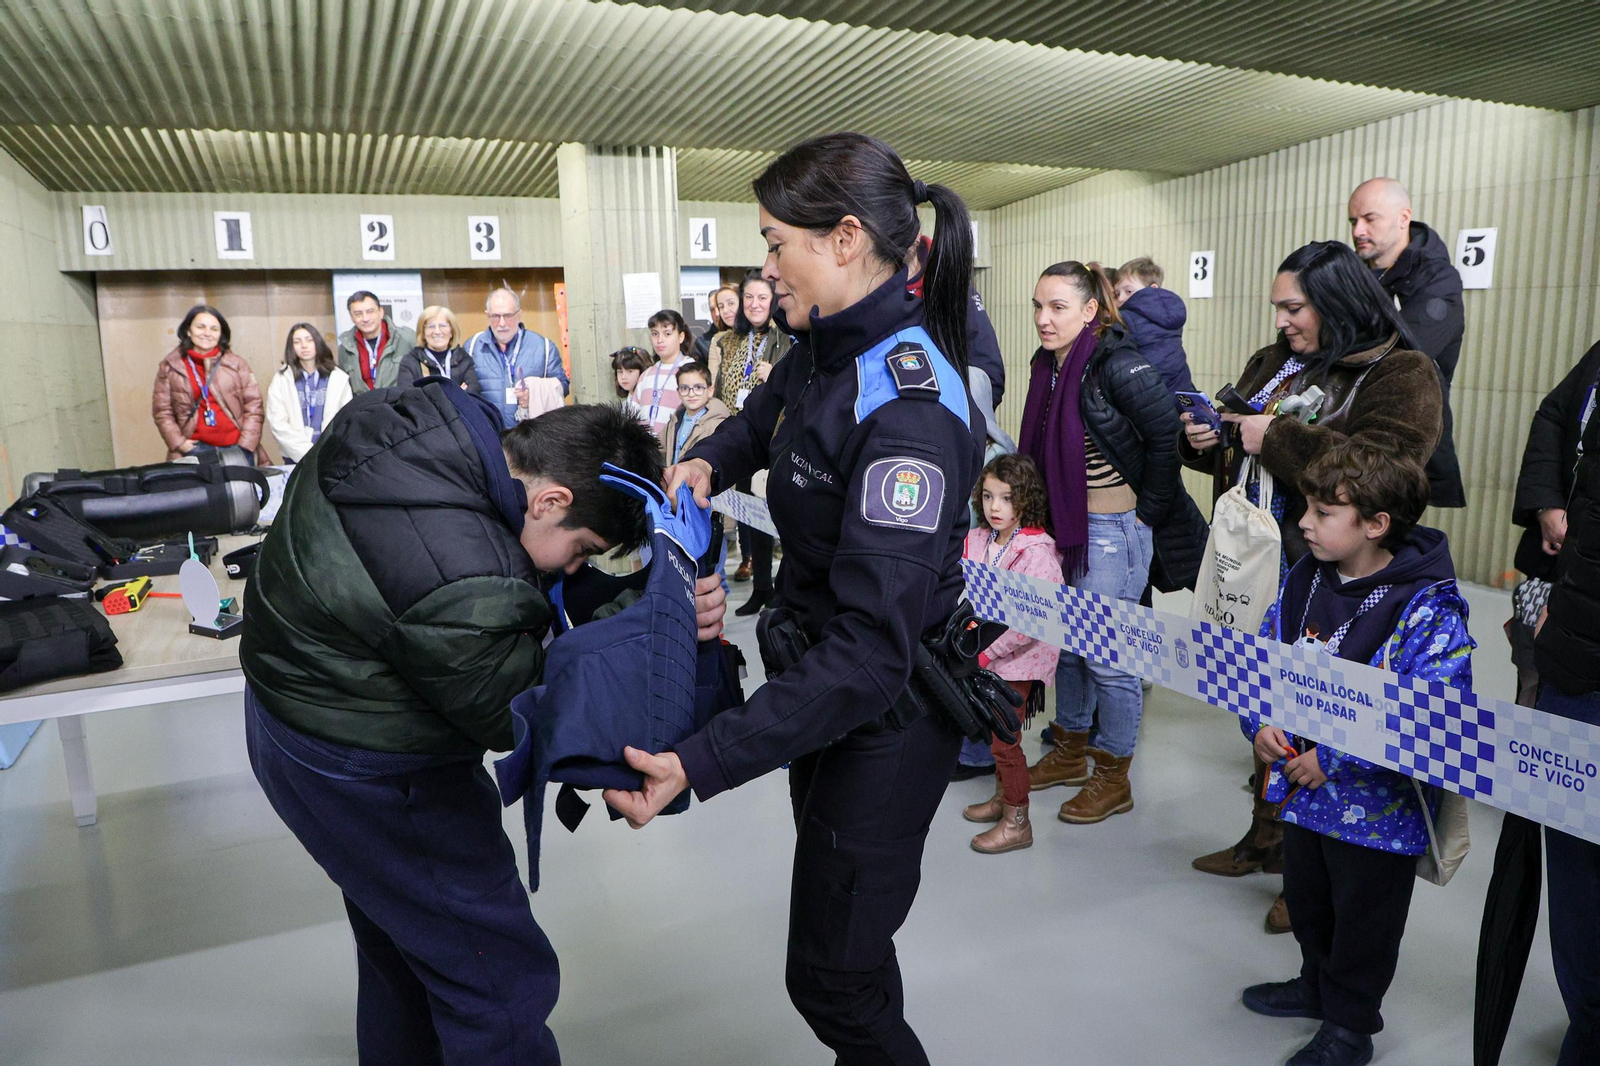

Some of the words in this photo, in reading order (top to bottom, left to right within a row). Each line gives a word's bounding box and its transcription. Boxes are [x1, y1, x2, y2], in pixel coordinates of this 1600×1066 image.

[220, 218, 247, 251] 1
[367, 221, 389, 252] 2
[475, 222, 495, 252] 3
[694, 223, 711, 251] 4
[1462, 235, 1486, 267] 5
[1194, 256, 1208, 280] 3
[792, 471, 808, 488] VIGO
[895, 516, 909, 524] Vigo
[684, 585, 696, 609] VIG
[1003, 585, 1030, 602] POLICIA
[1030, 594, 1054, 609] LOCAL
[1014, 601, 1025, 612] NO
[1026, 605, 1048, 620] PASAR
[1120, 623, 1163, 645] CONCELLO
[1127, 636, 1138, 647] DE
[1139, 640, 1159, 655] VIGO
[1280, 668, 1328, 694] POLICIA
[1330, 683, 1373, 708] LOCAL
[1296, 691, 1313, 708] NO
[1316, 697, 1357, 723] PASAR
[1509, 740, 1597, 778] CONCELLO
[1518, 759, 1539, 778] DE
[1545, 767, 1585, 793] VIGO
